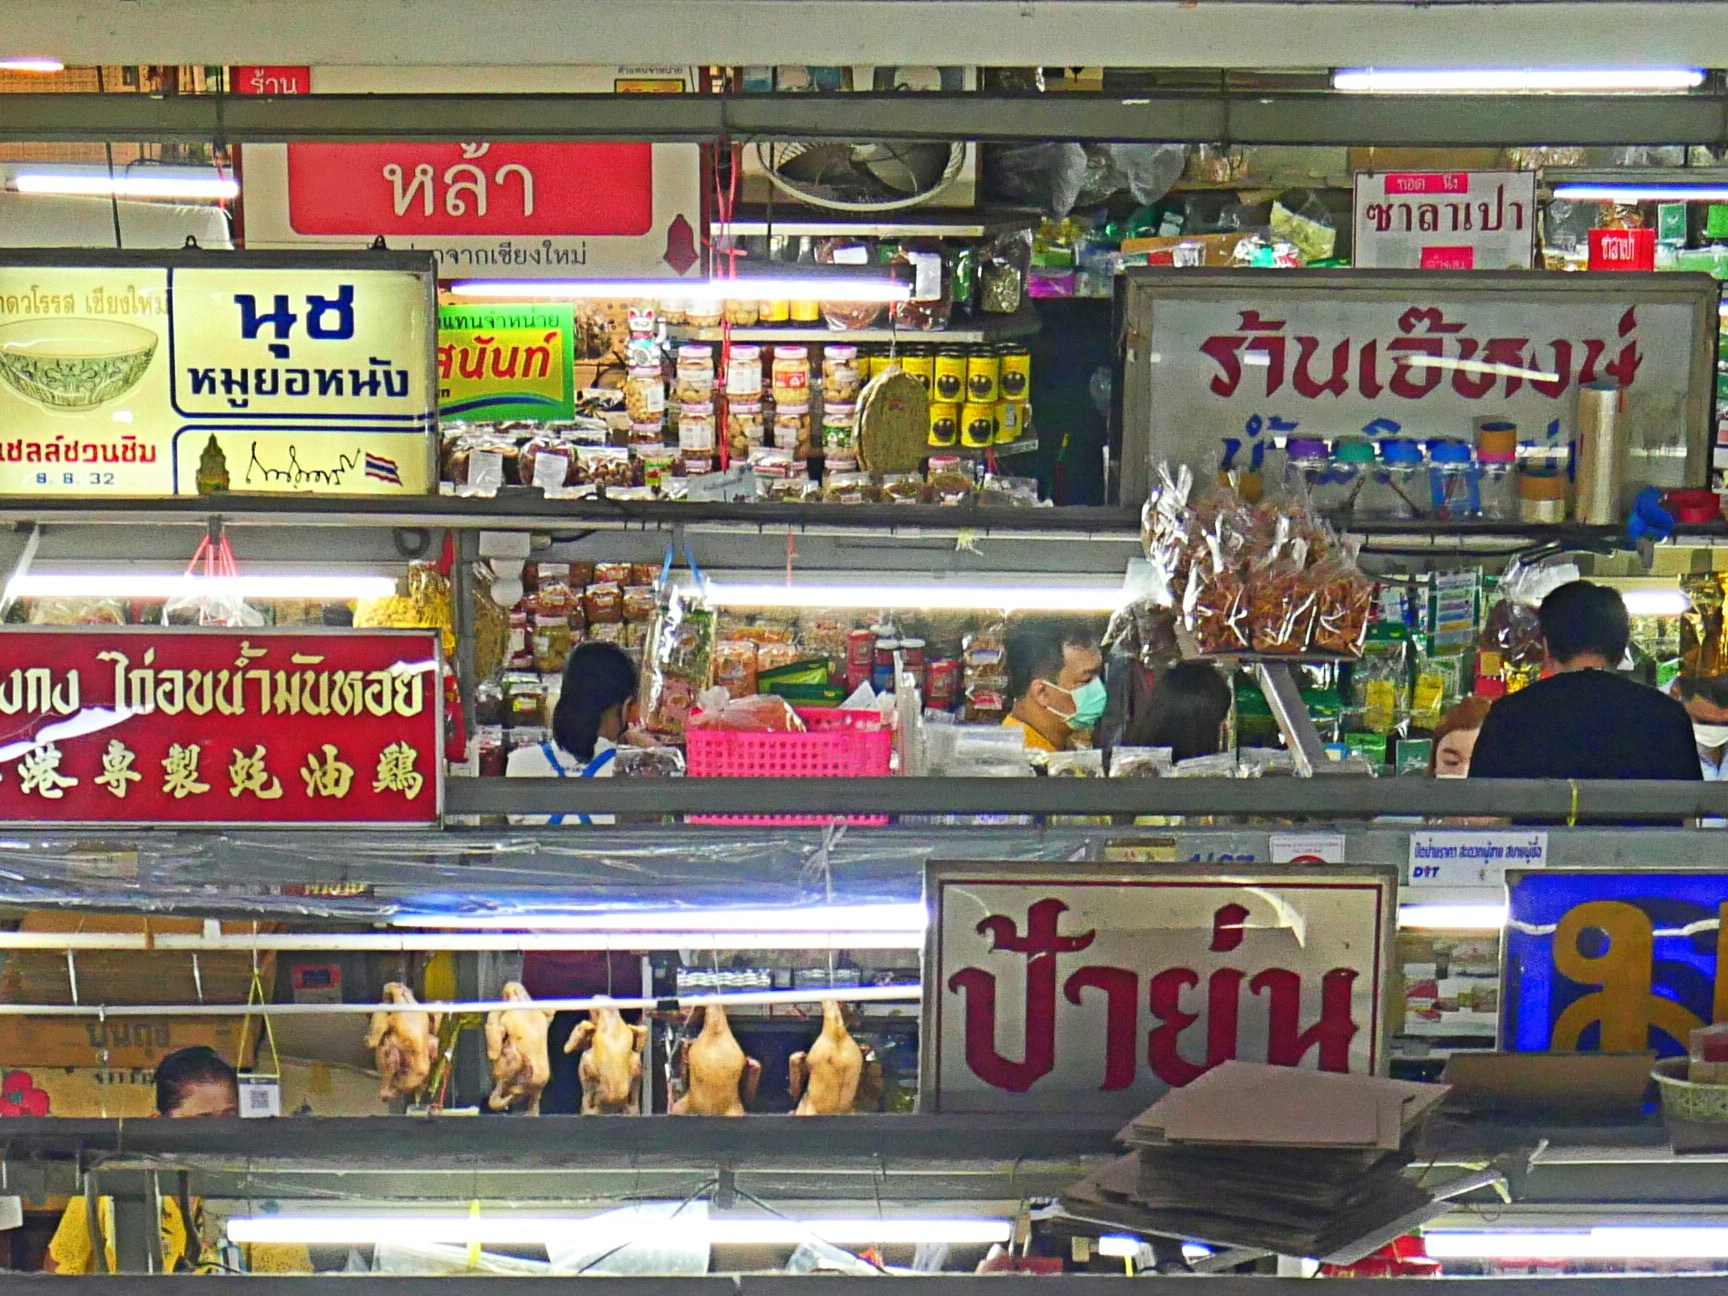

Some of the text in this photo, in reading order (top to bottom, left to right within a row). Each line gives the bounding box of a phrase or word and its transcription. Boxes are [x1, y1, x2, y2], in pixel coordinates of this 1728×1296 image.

[1366, 183, 1523, 233] ซาลาเปา
[233, 283, 355, 359] นุช
[187, 356, 409, 409] หมูยอหนัง
[97, 640, 424, 718] ไก่อบน้ำมันหอย
[948, 896, 1361, 1092] ป้าย่น
